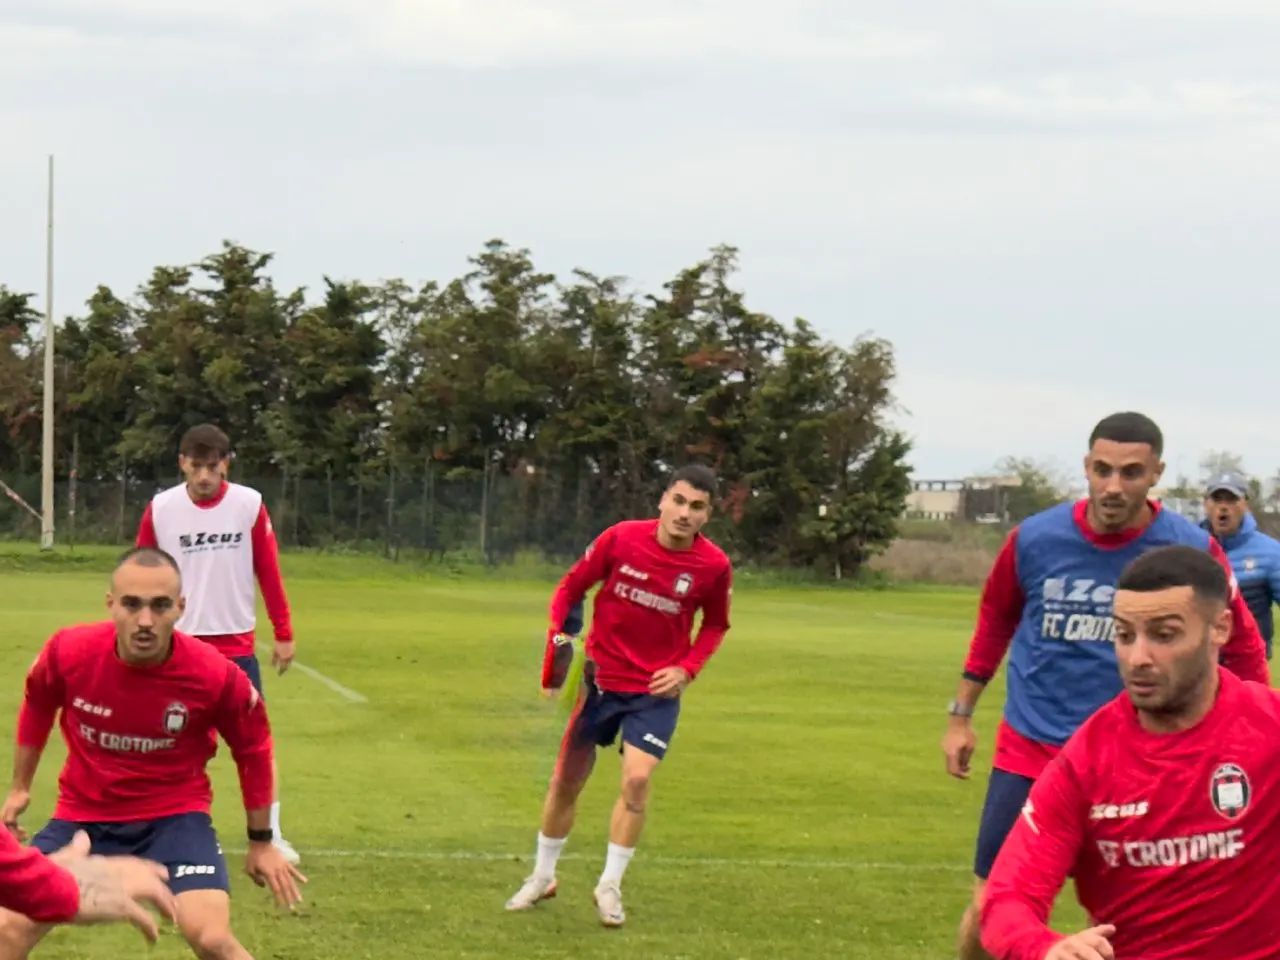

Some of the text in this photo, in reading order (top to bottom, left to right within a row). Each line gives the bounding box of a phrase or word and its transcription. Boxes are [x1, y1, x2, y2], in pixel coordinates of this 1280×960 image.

[194, 531, 244, 546] Zeus
[1065, 578, 1117, 604] Ze
[1041, 613, 1065, 639] FC
[80, 723, 177, 754] FC CROTONE
